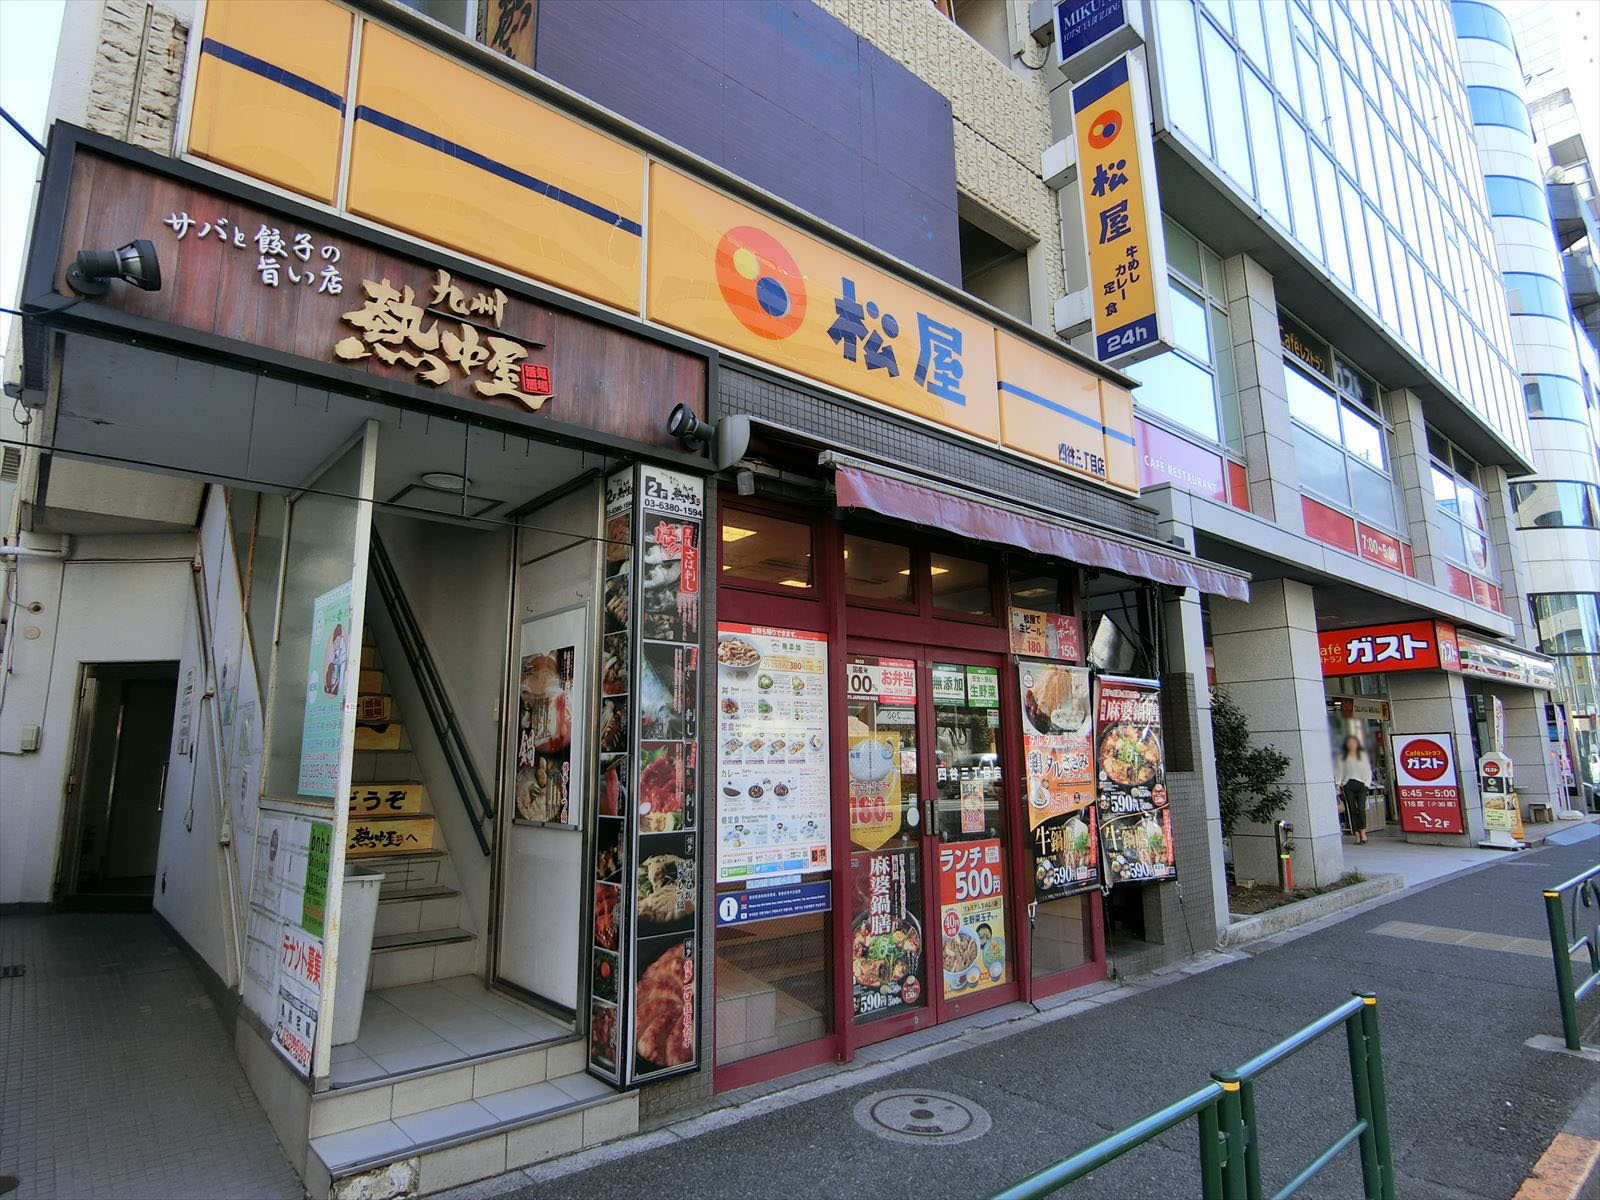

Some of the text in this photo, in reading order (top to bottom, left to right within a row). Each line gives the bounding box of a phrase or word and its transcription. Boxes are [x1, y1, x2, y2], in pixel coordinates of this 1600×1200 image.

[1090, 158, 1132, 245] 松屋
[163, 211, 341, 263] サバと餃子の
[1125, 244, 1141, 285] 牛めし
[1114, 263, 1128, 301] カレー
[430, 268, 508, 329] 九州
[1103, 280, 1118, 317] 定食
[826, 276, 967, 407] 松屋
[1106, 325, 1148, 353] 24h
[644, 498, 703, 517] 03-6380-1594
[1024, 614, 1041, 624] 松屋で
[1346, 633, 1429, 665] ガスト
[881, 670, 913, 688] お弁当
[932, 676, 964, 691] 無添加
[970, 684, 997, 698] 生野菜
[937, 766, 1002, 782] 四谷三丁目店
[1407, 757, 1444, 769] ガスト
[1401, 789, 1422, 798] 6:45
[1434, 818, 1450, 829] 2F
[940, 846, 982, 872] ランチ
[955, 867, 1001, 900] 500円
[282, 933, 322, 991] テナント募集
